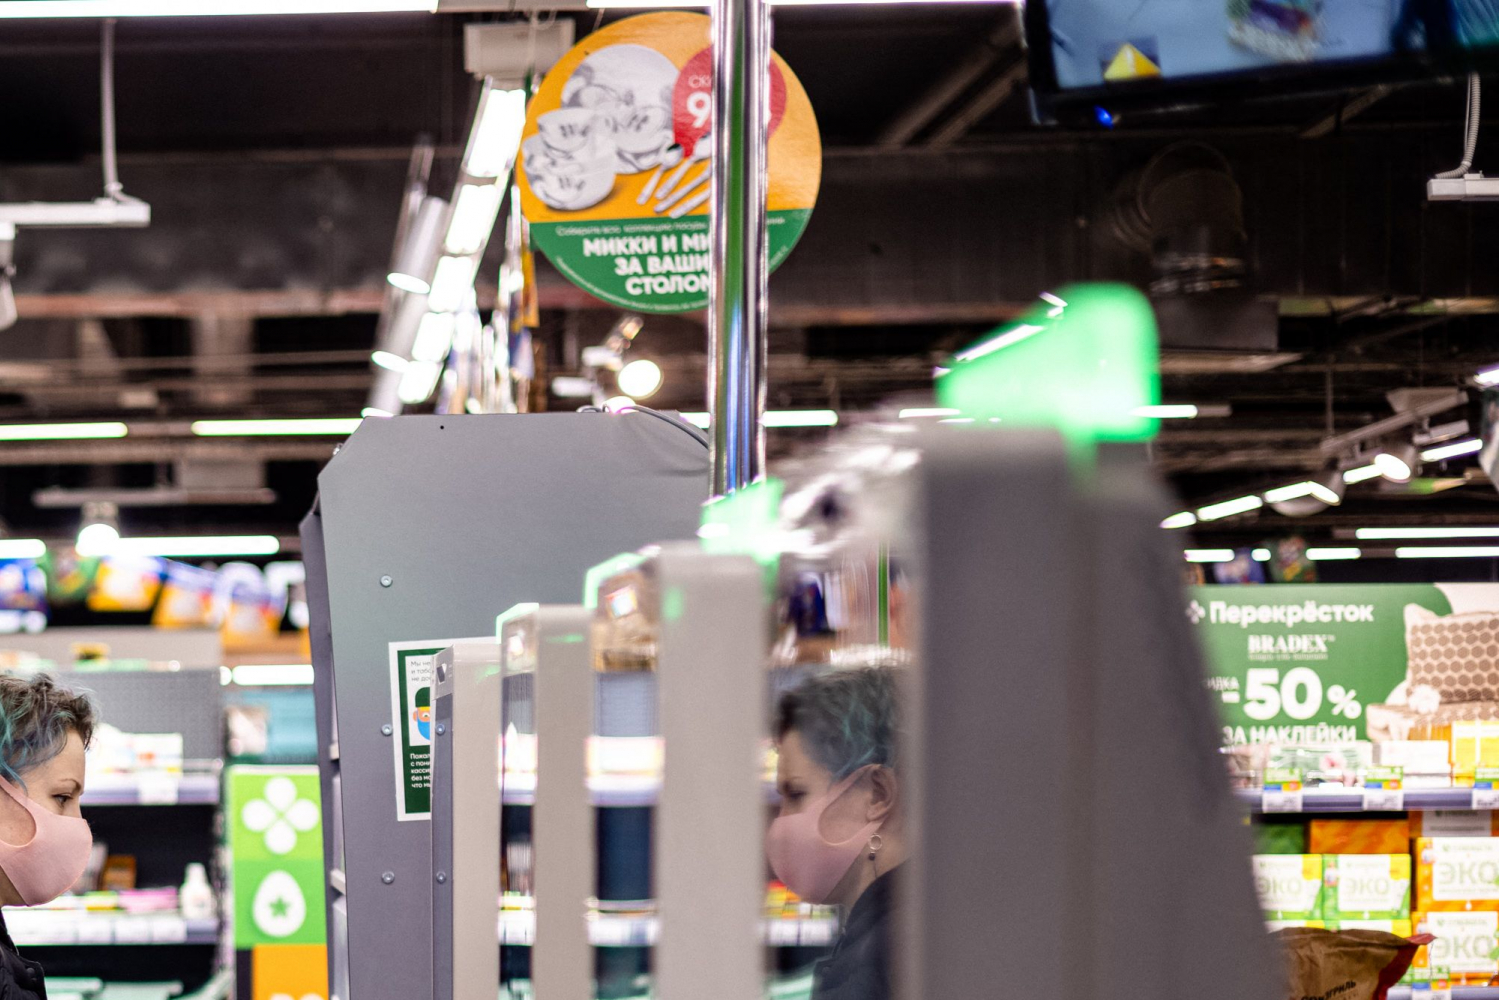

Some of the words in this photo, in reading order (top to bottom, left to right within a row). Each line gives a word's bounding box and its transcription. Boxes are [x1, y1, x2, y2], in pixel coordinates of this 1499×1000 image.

[583, 235, 657, 257] МИККИ
[661, 234, 677, 253] И
[682, 232, 712, 251] МИ
[614, 256, 643, 276] ЗА
[647, 253, 711, 274] ВАШИ
[1210, 600, 1374, 628] Перекрёсток
[1248, 634, 1328, 653] BRADEX
[1223, 726, 1247, 745] ЗА
[1251, 722, 1357, 745] НАКЛЕЙКИ
[1439, 861, 1499, 885] ЭКО
